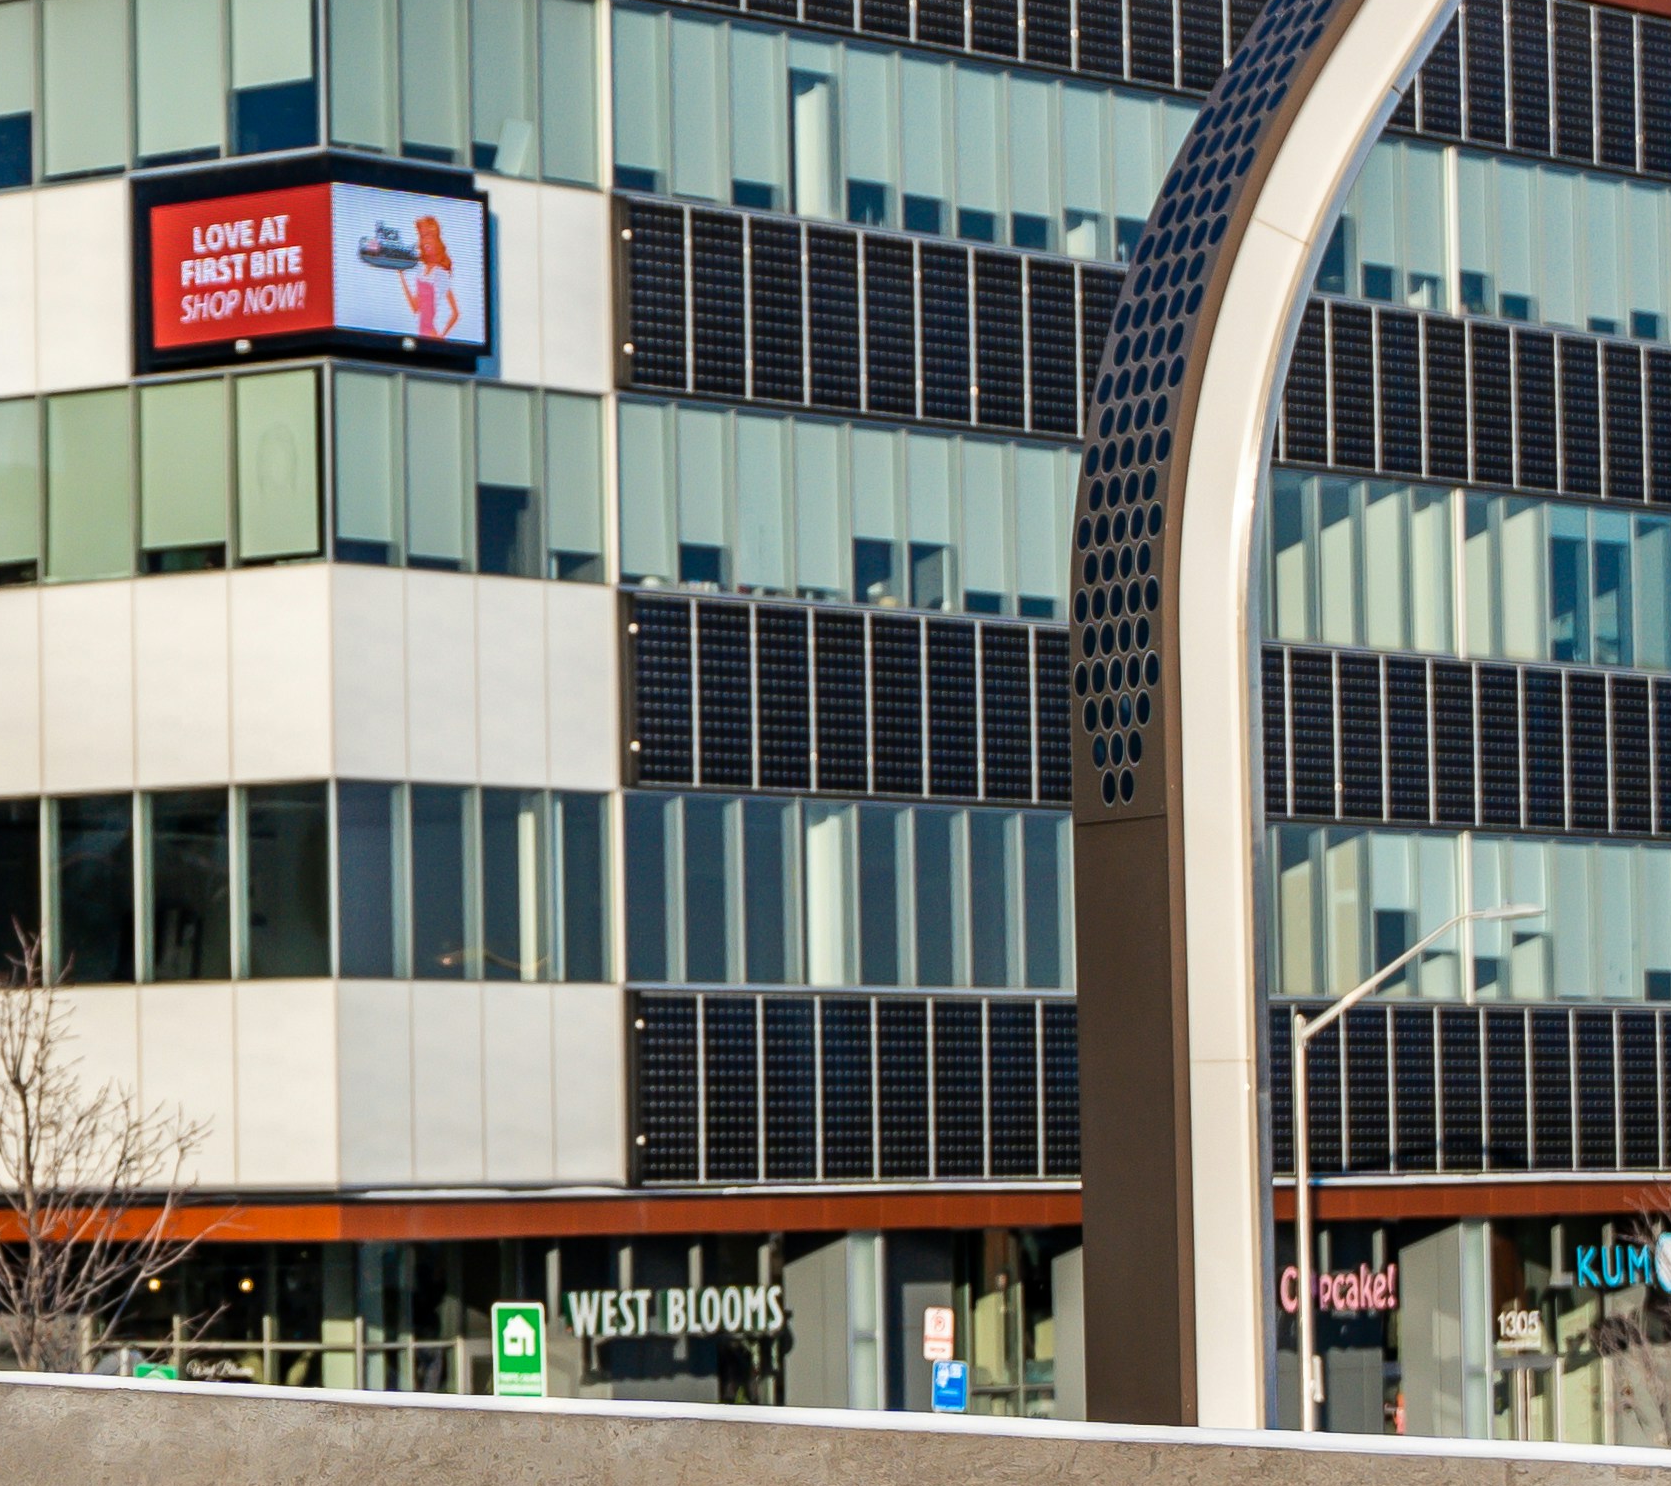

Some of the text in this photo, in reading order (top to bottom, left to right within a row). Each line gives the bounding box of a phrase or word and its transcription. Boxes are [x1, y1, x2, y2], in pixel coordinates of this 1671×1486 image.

[192, 214, 290, 253] LOVE AT
[180, 245, 304, 287] FIRST BITE
[179, 281, 308, 324] SHOP NOW!
[1280, 1262, 1398, 1313] Cpcake!
[566, 1284, 785, 1338] WEST BLOOMS
[1497, 1309, 1542, 1338] 1305
